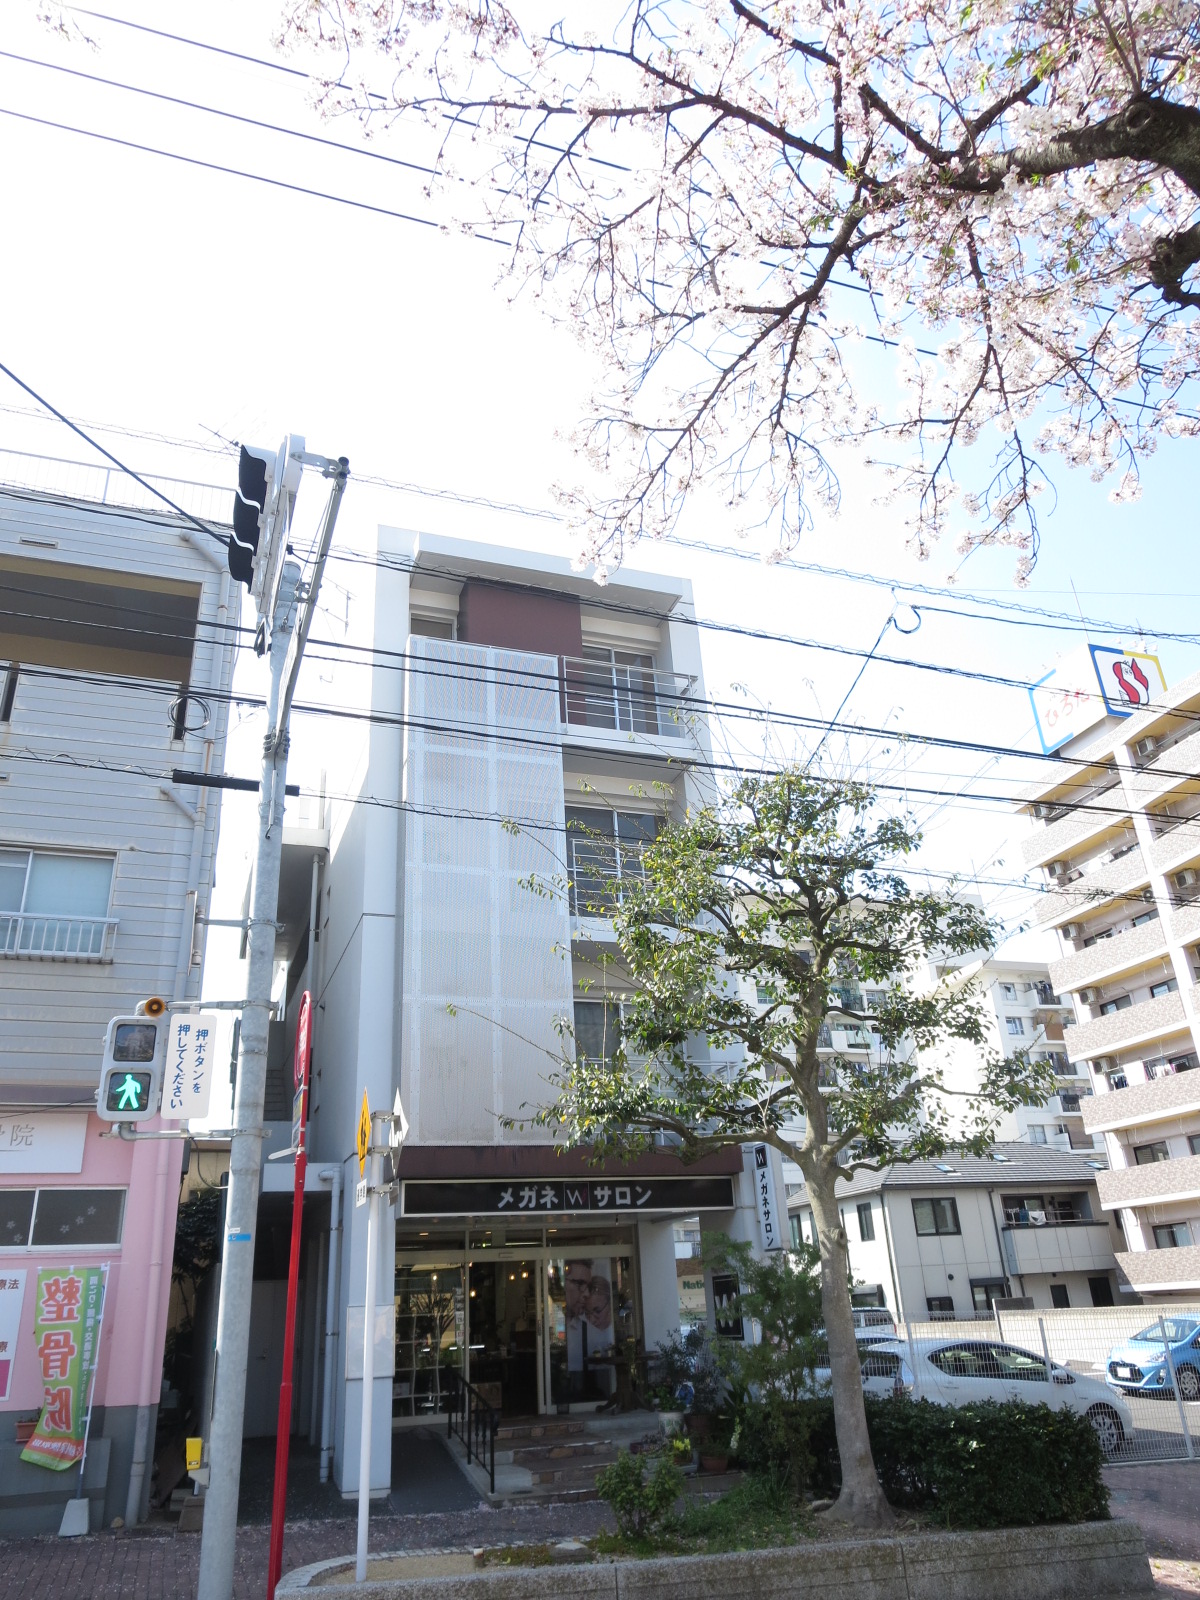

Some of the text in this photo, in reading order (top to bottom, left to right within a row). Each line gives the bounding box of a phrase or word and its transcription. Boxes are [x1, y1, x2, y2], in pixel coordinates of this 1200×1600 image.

[170, 1024, 191, 1110] 押してください
[194, 1029, 209, 1094] 押ボタンを
[497, 1185, 559, 1209] メガネ
[593, 1185, 652, 1208] サロン
[760, 1171, 774, 1248] メガネサロン
